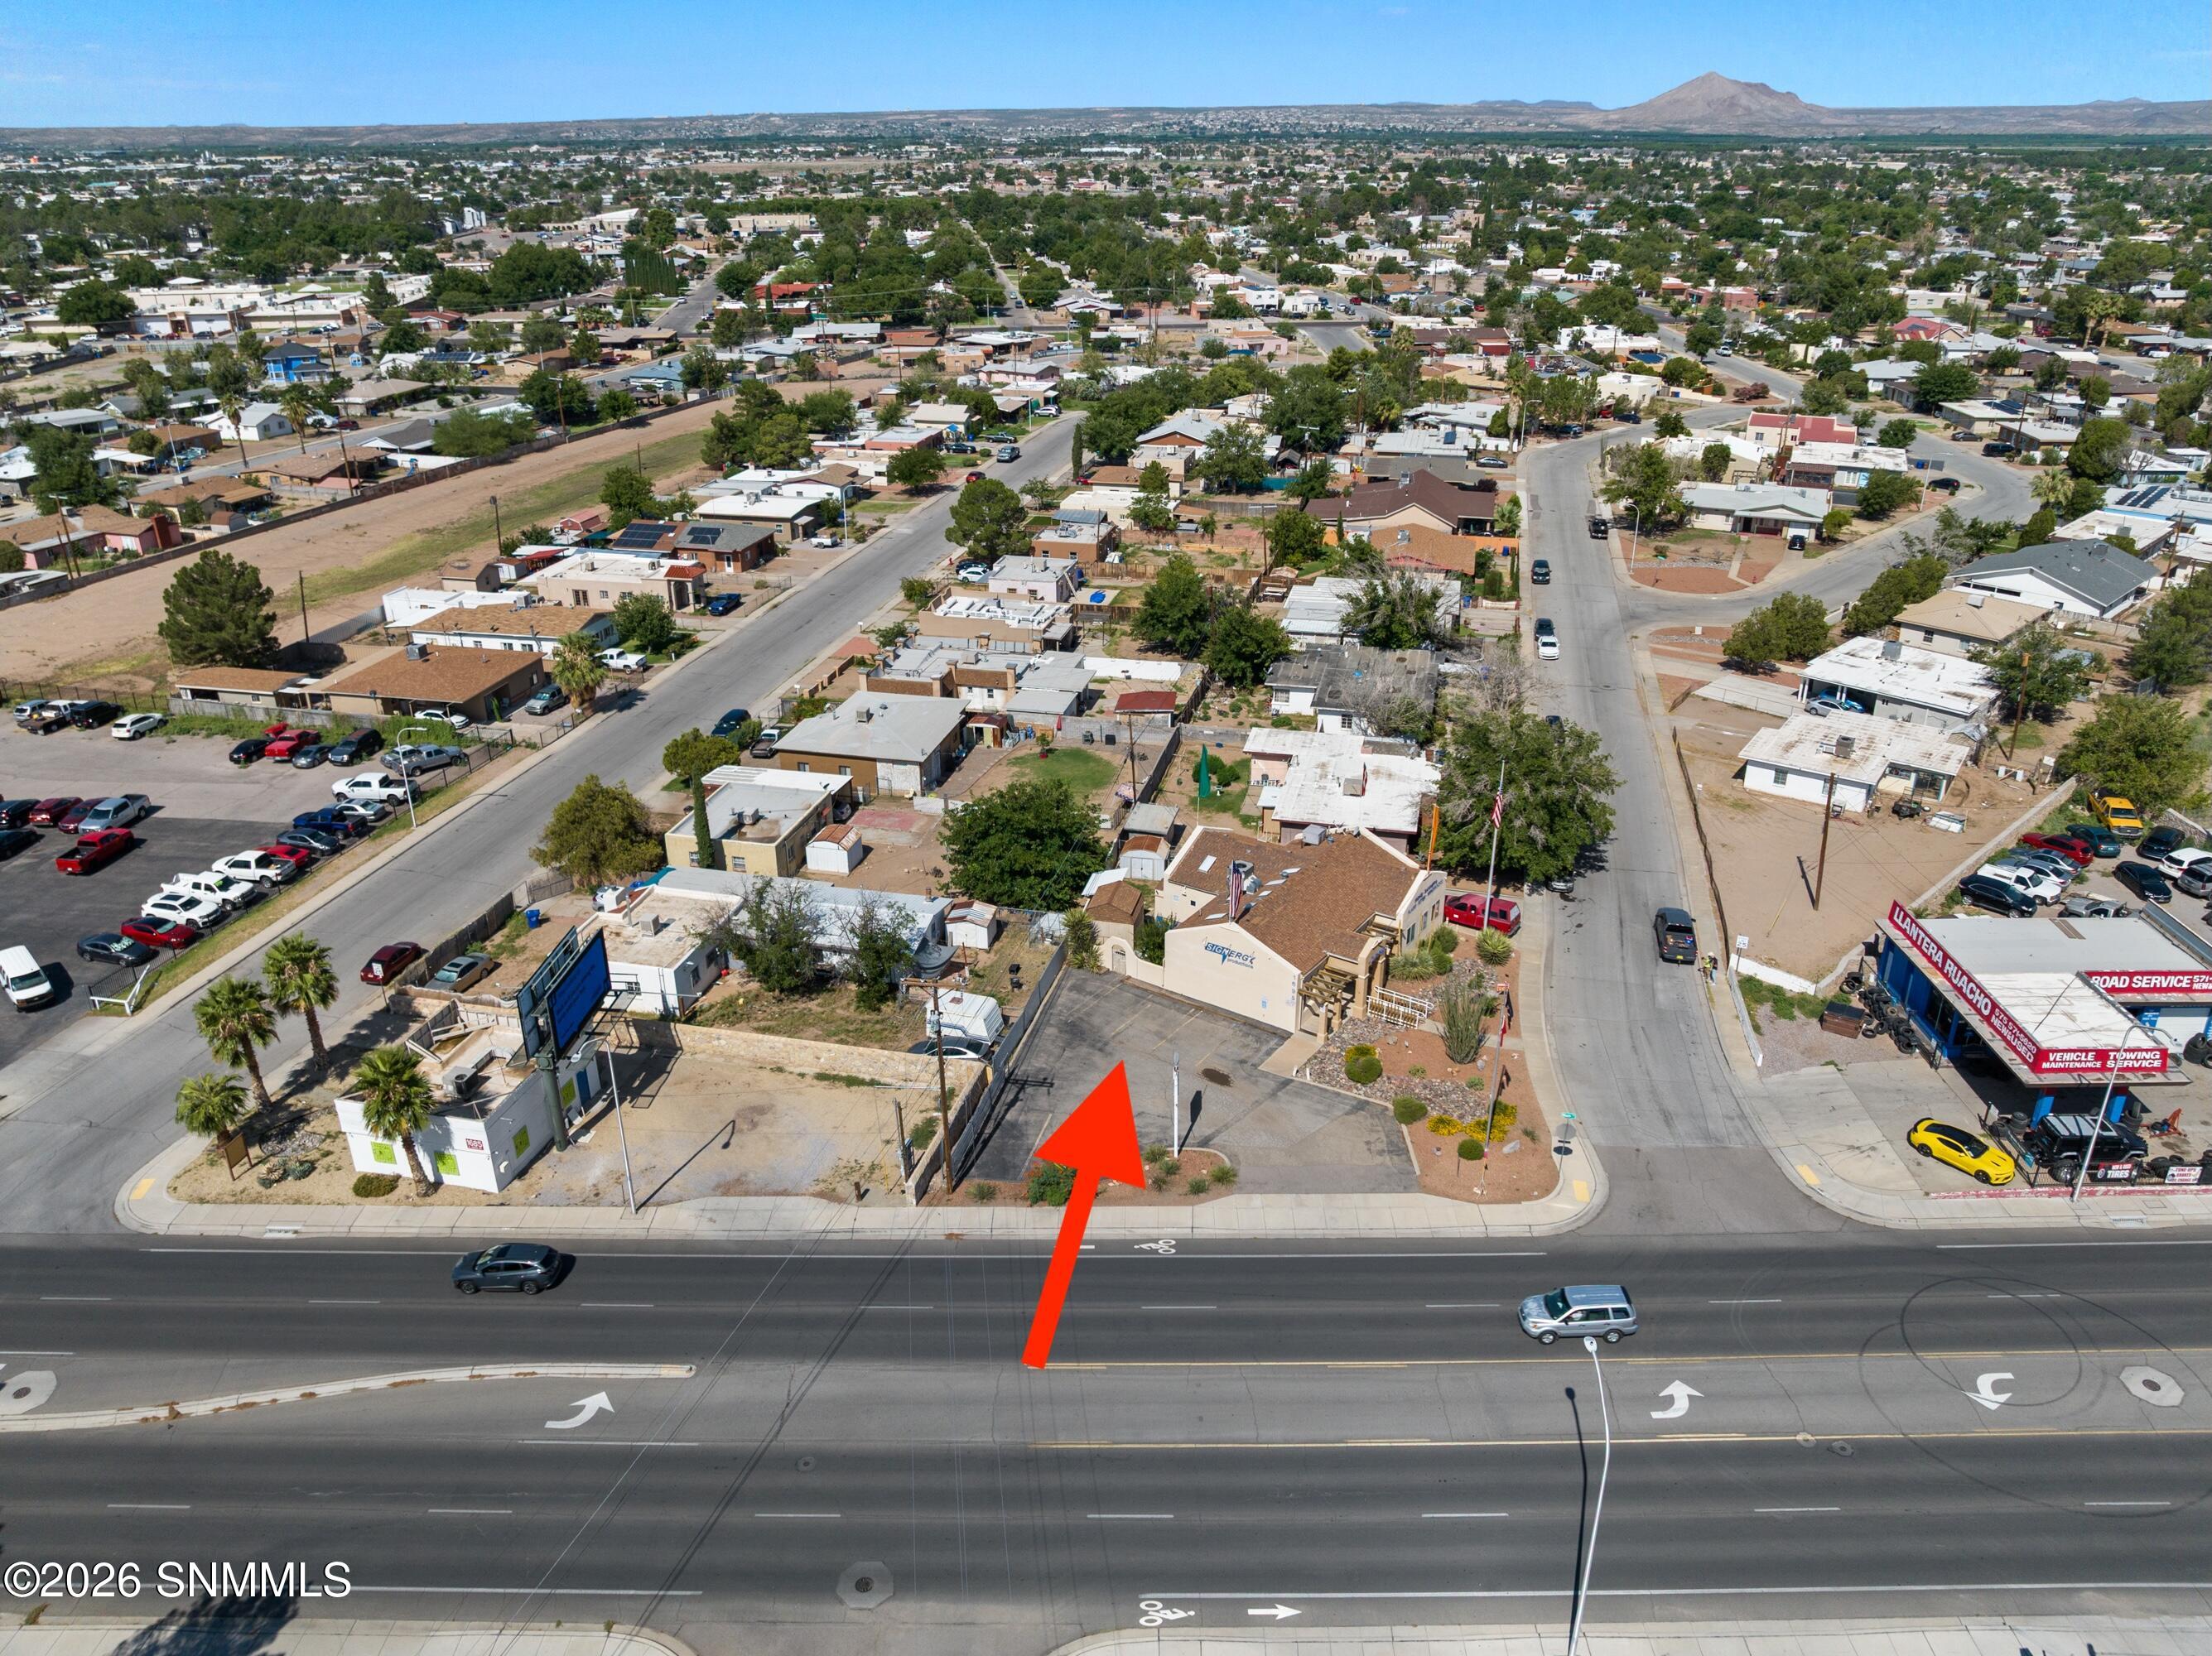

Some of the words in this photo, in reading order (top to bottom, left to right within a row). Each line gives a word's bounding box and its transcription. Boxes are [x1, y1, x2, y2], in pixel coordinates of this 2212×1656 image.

[1893, 907, 1944, 967] LLANTERA
[1944, 959, 1992, 1016] RUACHO
[2091, 975, 2129, 988] ROAD
[2131, 975, 2193, 988] SERVICE
[2049, 1052, 2096, 1061] VEHICLE
[2108, 1052, 2161, 1060] TOWING
[2041, 1061, 2102, 1069] MAINTENANCE
[2106, 1060, 2162, 1068] SERVICE
[2107, 1170, 2130, 1178] TIRES
